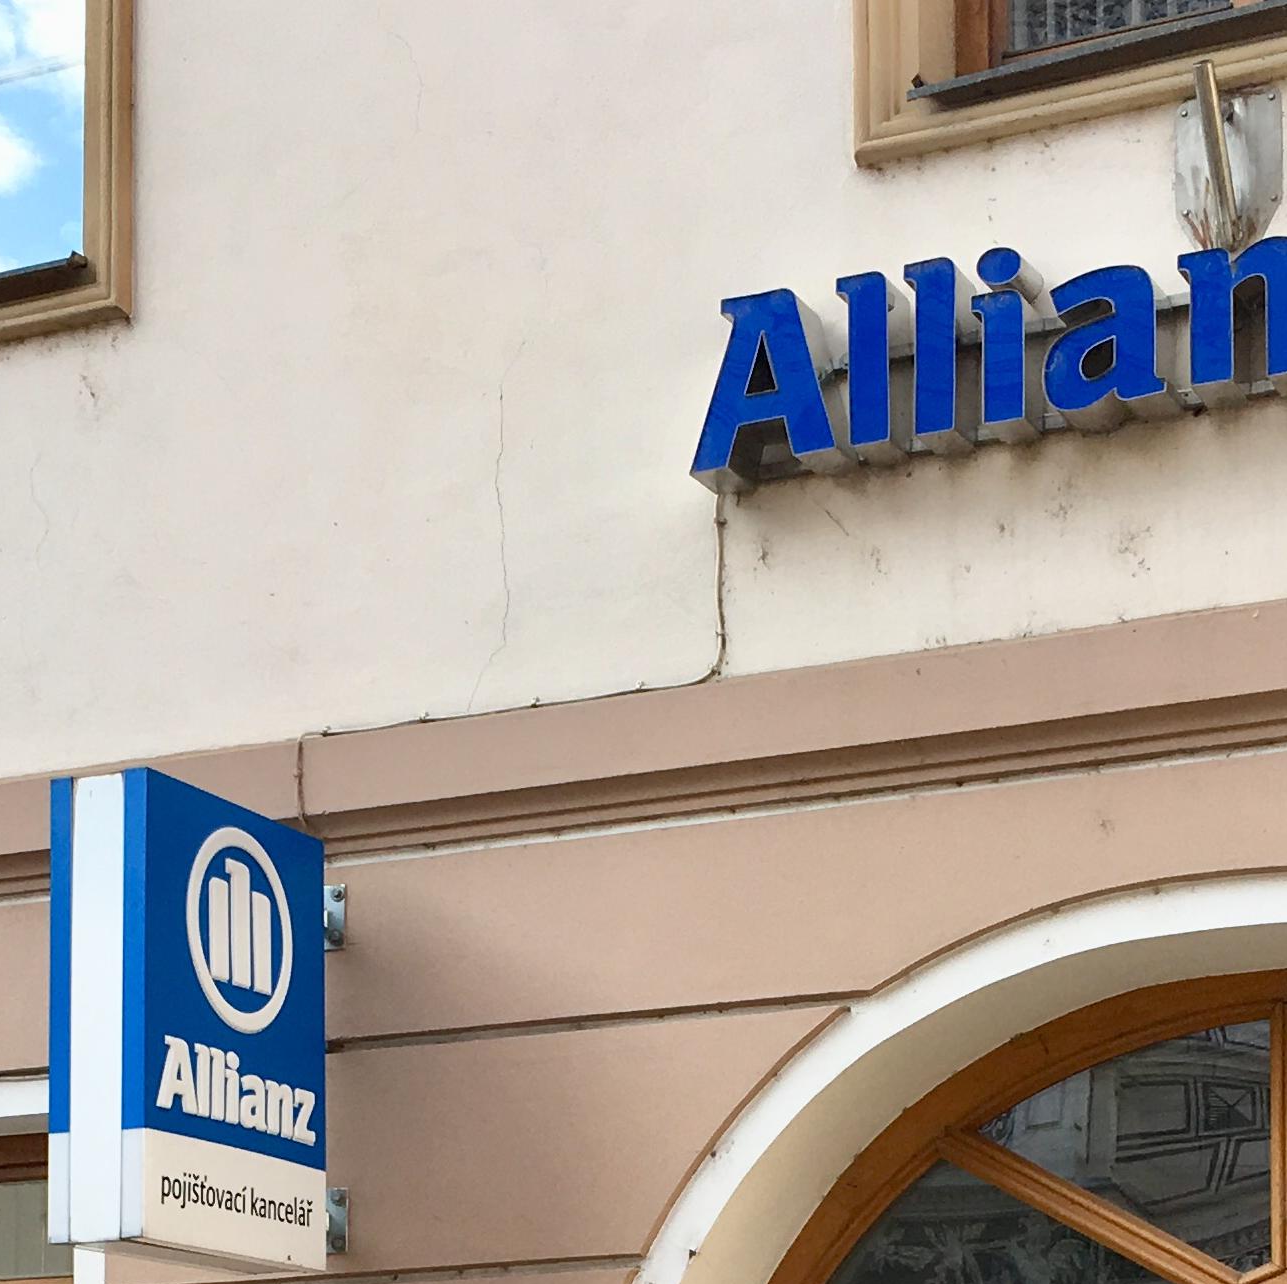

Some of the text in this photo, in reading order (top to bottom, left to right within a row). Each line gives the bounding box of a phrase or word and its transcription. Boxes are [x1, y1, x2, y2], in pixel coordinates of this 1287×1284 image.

[156, 1035, 316, 1147] Allianz
[160, 1171, 314, 1229] pojišťovací kancelář
